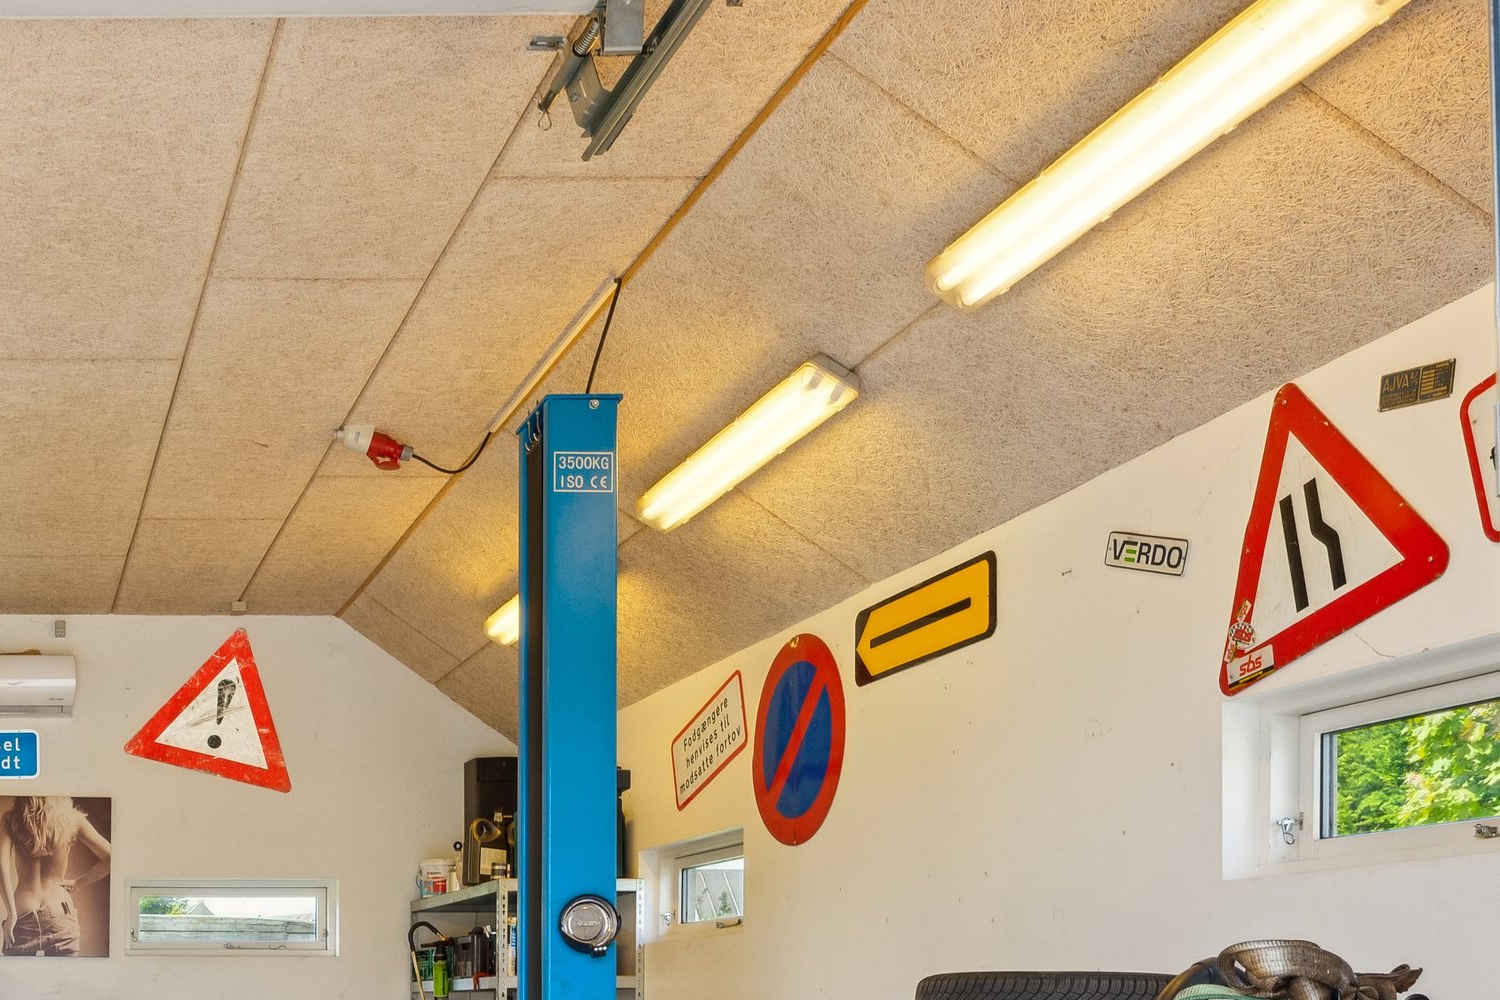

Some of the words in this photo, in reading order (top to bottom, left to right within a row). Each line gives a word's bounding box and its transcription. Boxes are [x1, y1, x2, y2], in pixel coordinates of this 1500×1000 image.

[1382, 374, 1410, 392] AJVA
[558, 456, 609, 469] 3500KG
[561, 475, 584, 488] ISO
[1113, 538, 1184, 569] VERDO
[1239, 654, 1263, 678] sbs
[683, 697, 729, 753] Fodgængere
[685, 729, 718, 769] henvises
[719, 714, 731, 733] til
[679, 754, 715, 796] modsatte
[715, 725, 741, 758] fortov
